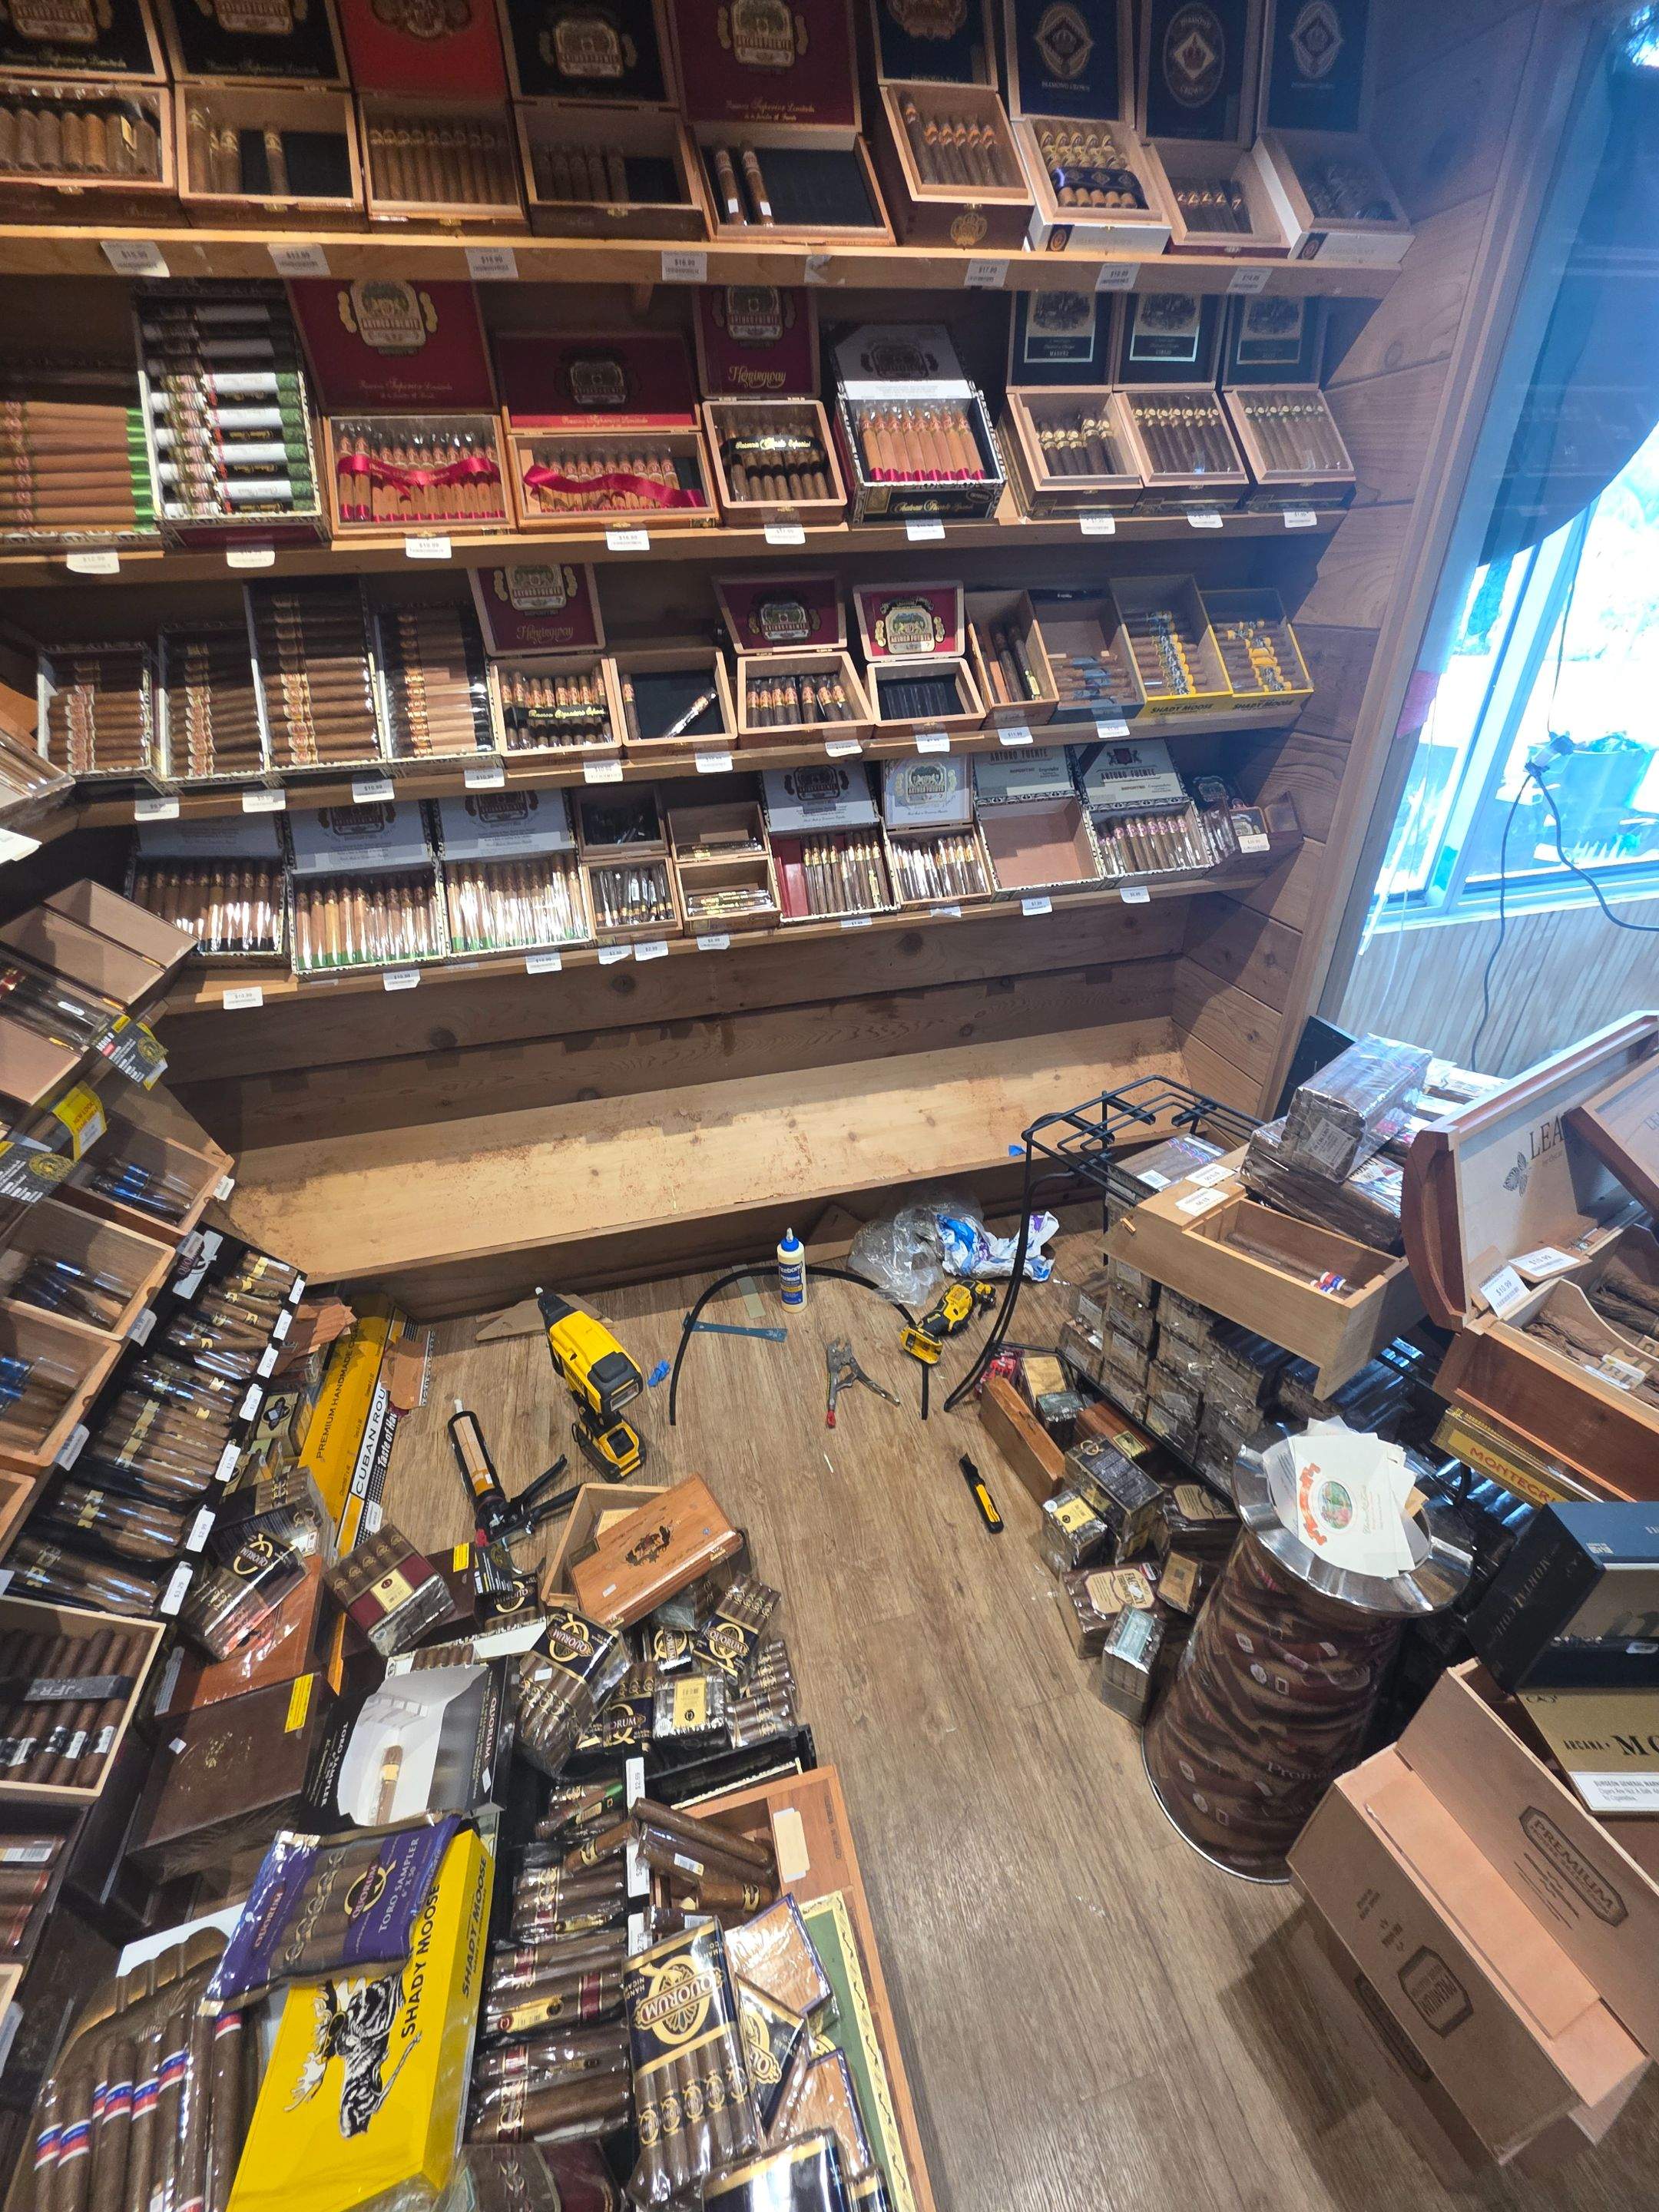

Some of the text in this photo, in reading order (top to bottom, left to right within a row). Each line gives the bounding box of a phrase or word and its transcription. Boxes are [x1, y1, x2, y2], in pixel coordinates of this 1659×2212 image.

[728, 366, 786, 388] Hemingway
[990, 748, 1048, 762] ARTURO FUENTE
[1101, 768, 1156, 780] ARTURO FUENTE
[1530, 1115, 1565, 1161] LEA
[1495, 1279, 1512, 1296] $10.99
[316, 1402, 336, 1459] PREMIUM
[331, 1349, 353, 1406] HANDMADE
[356, 1428, 377, 1495] CUBAN
[373, 1388, 386, 1423] ROU
[377, 1441, 391, 1469] Taste
[386, 1427, 393, 1443] of
[240, 1547, 269, 1568] QUORUM
[552, 1628, 588, 1653] QUORUM
[708, 1631, 744, 1654] QUORUM
[40, 1685, 75, 1697] JFR
[336, 1720, 349, 1754] TORO
[484, 1696, 498, 1758] QUORUM
[1563, 1740, 1605, 1751] ARCANA
[321, 1753, 340, 1807] SAMPLER
[379, 1836, 420, 1934] TORO SAMPLER
[1532, 1820, 1614, 1909] PREMIUM
[351, 1863, 379, 1920] QUORUM
[253, 1891, 284, 1949] QUORUM
[462, 1855, 488, 1998] SHADY MOOSE
[637, 1932, 645, 1952] 2.79
[401, 1960, 427, 2038] SHADY
[416, 1883, 441, 1956] MOOSE
[641, 1974, 716, 2021] QUORUM
